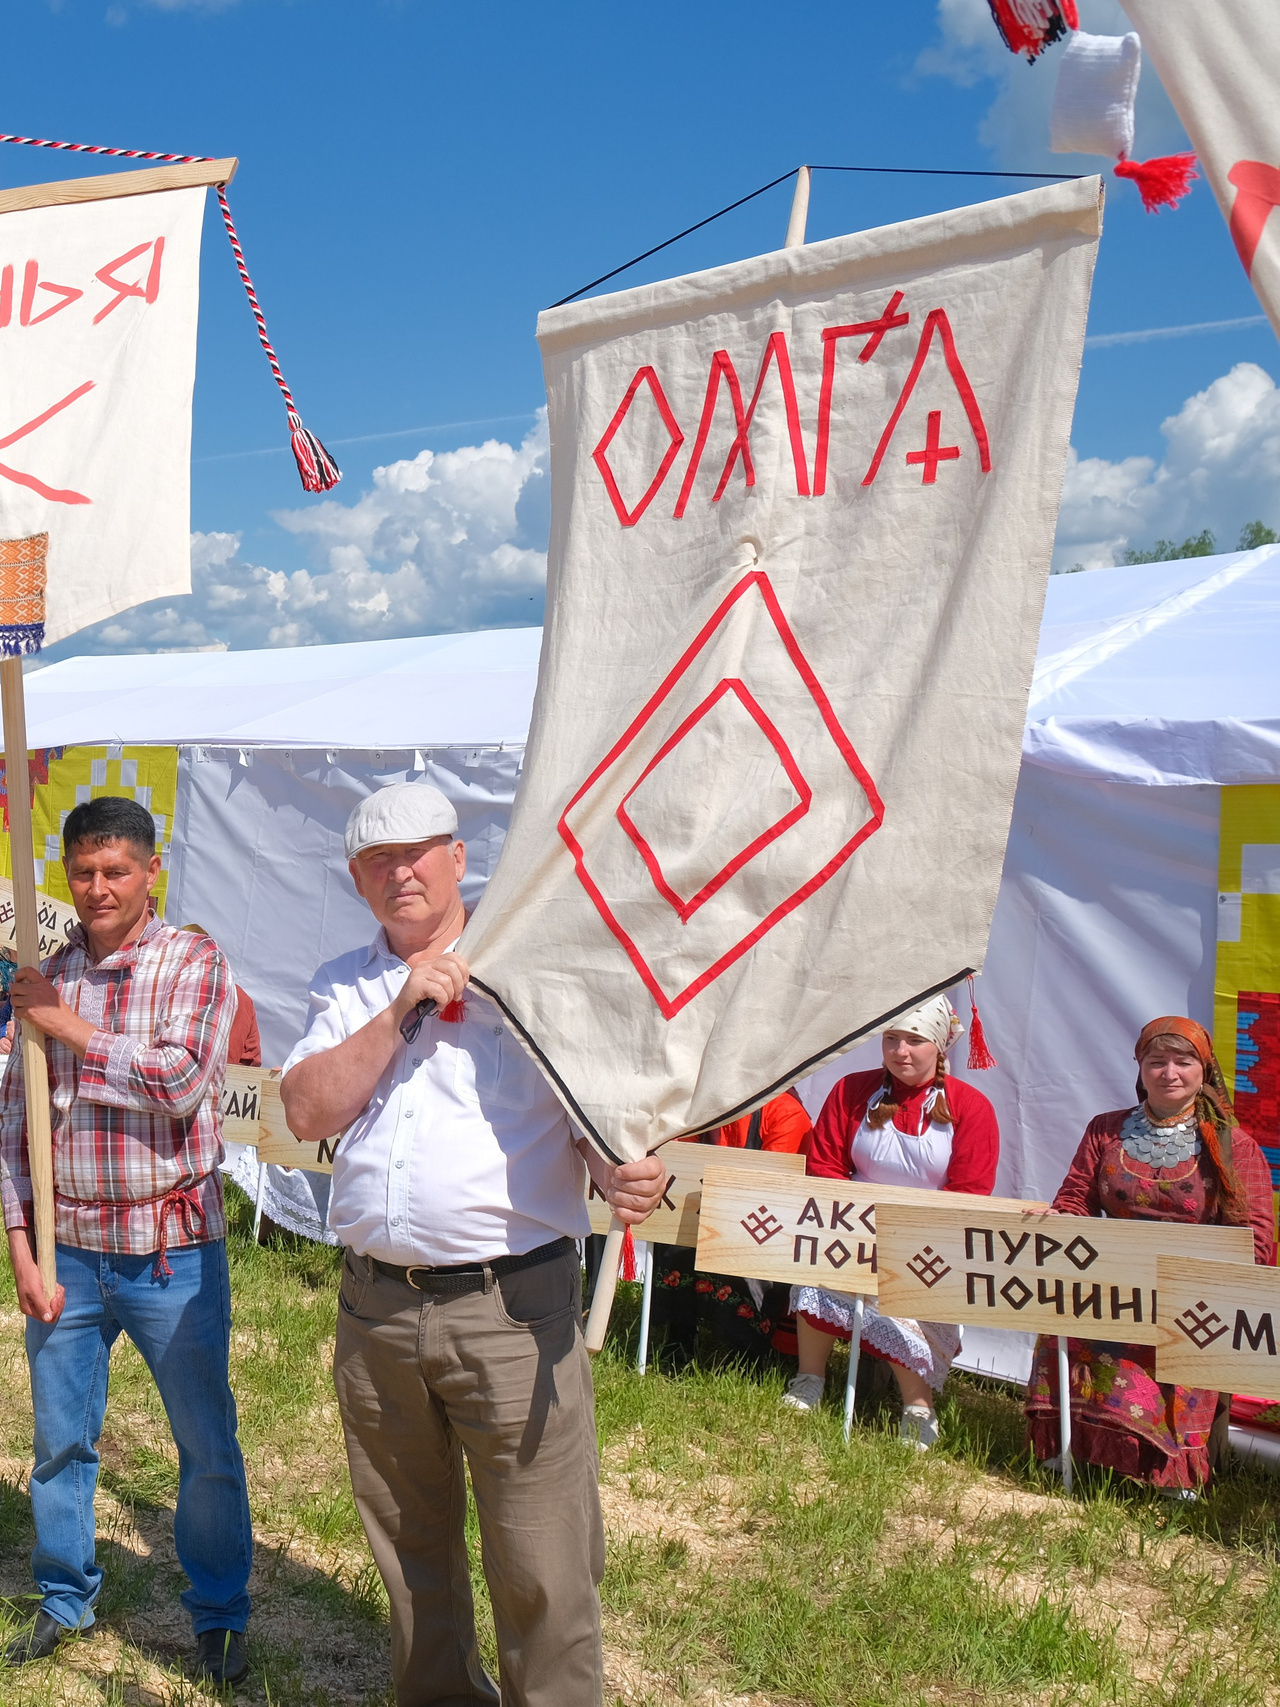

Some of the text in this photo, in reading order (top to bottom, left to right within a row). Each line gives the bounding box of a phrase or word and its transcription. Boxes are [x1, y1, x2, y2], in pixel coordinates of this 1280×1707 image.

[591, 290, 992, 527] ОМГА
[964, 1227, 1099, 1271] ПУРО
[966, 1272, 1157, 1325] ПОЧИН
